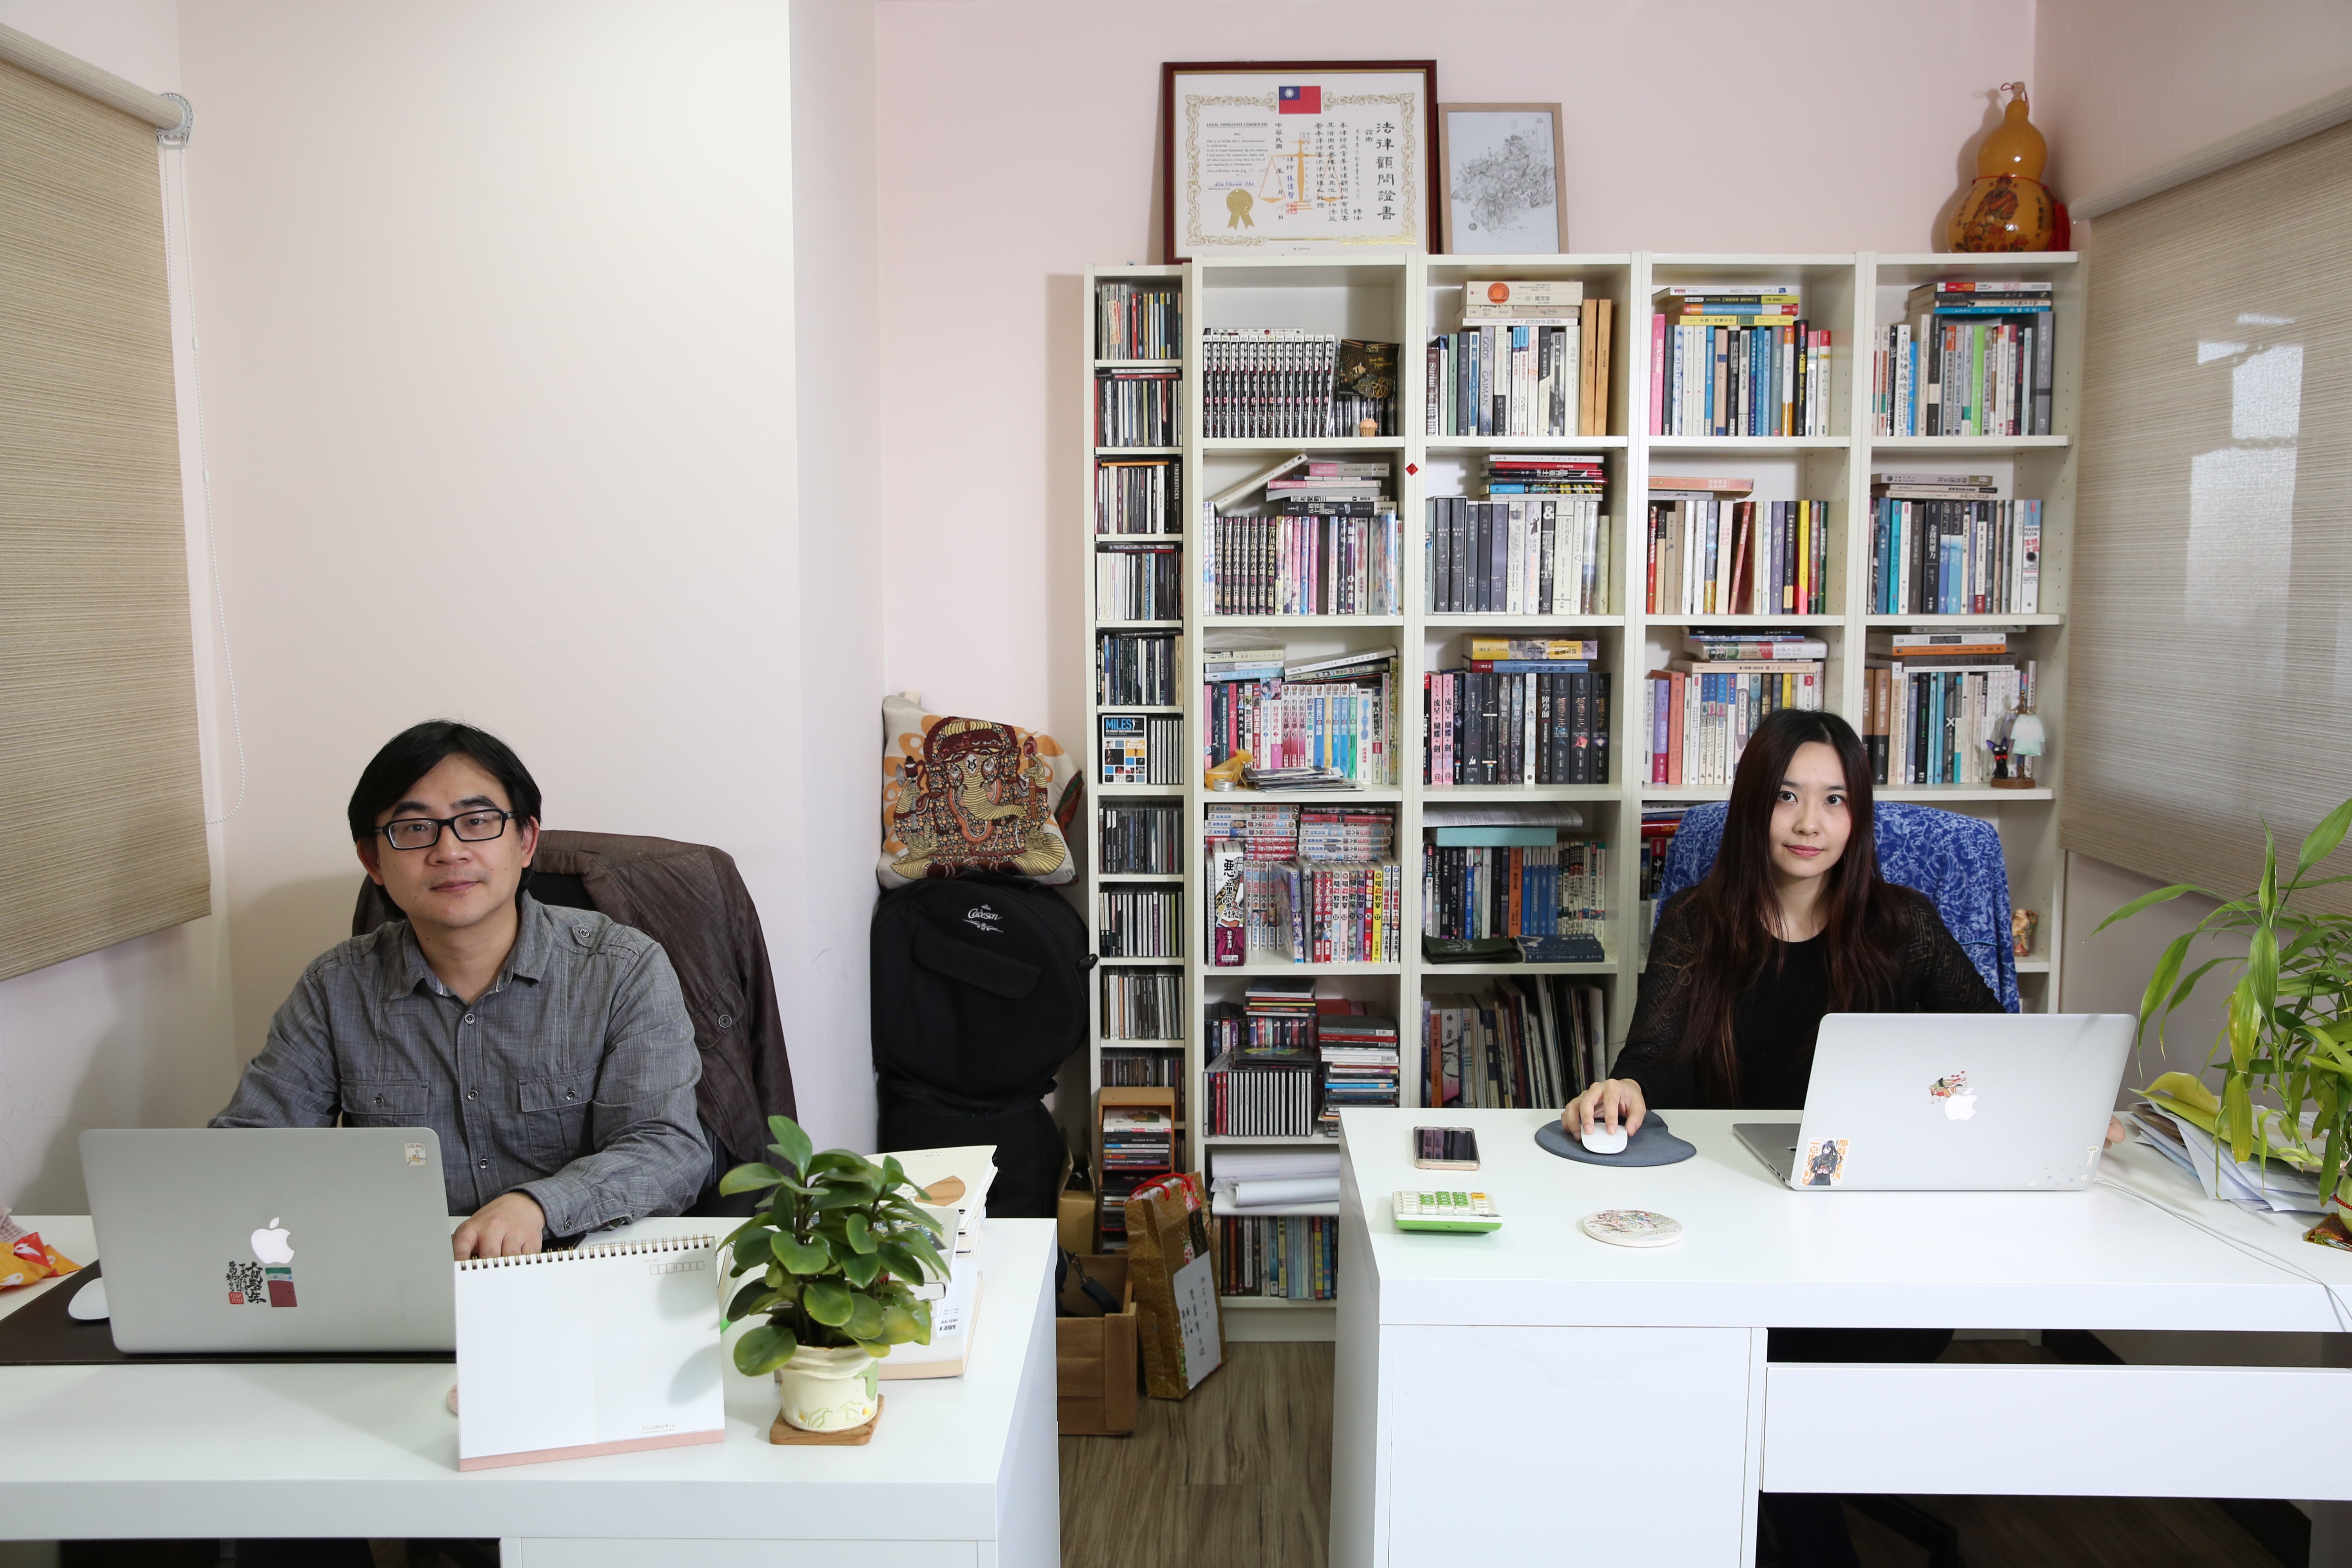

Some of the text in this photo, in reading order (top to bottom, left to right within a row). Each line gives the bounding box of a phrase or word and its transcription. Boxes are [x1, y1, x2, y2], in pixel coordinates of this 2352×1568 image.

[1275, 122, 1283, 150] 中華民國
[1375, 122, 1396, 220] 法律顧問證書
[1106, 719, 1132, 730] MILES
[968, 908, 1002, 920] Cadeson
